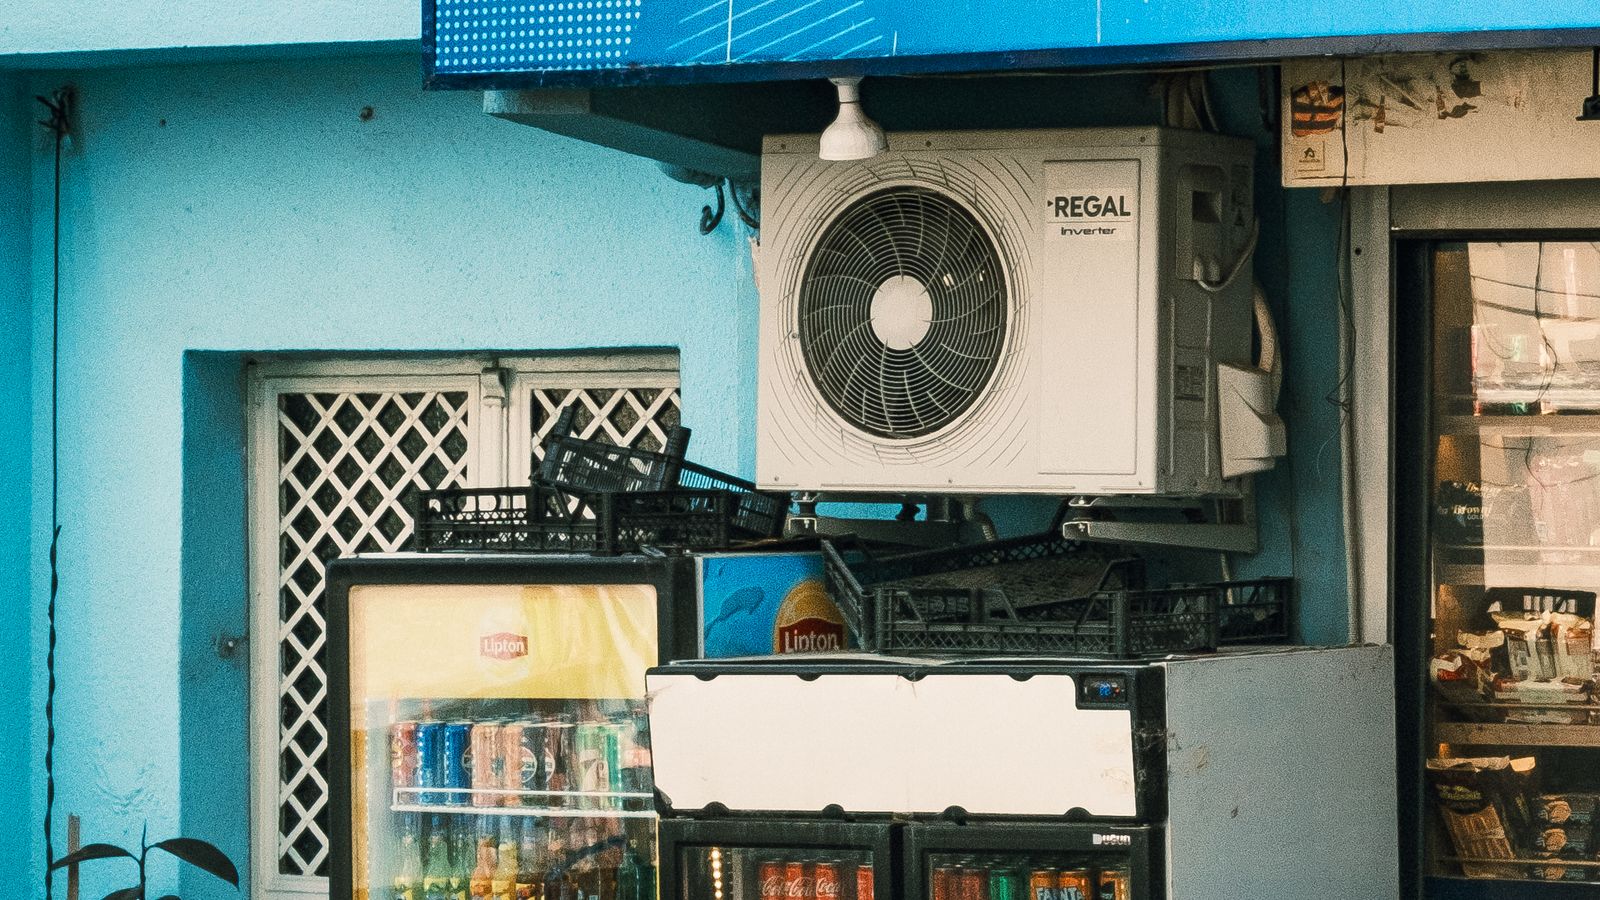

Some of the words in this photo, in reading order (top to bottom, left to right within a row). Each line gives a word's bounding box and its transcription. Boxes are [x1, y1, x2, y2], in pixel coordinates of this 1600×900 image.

[1055, 195, 1131, 217] REGAL
[1060, 226, 1116, 236] Inverter
[484, 637, 525, 659] Lipton
[784, 629, 839, 652] Lipton
